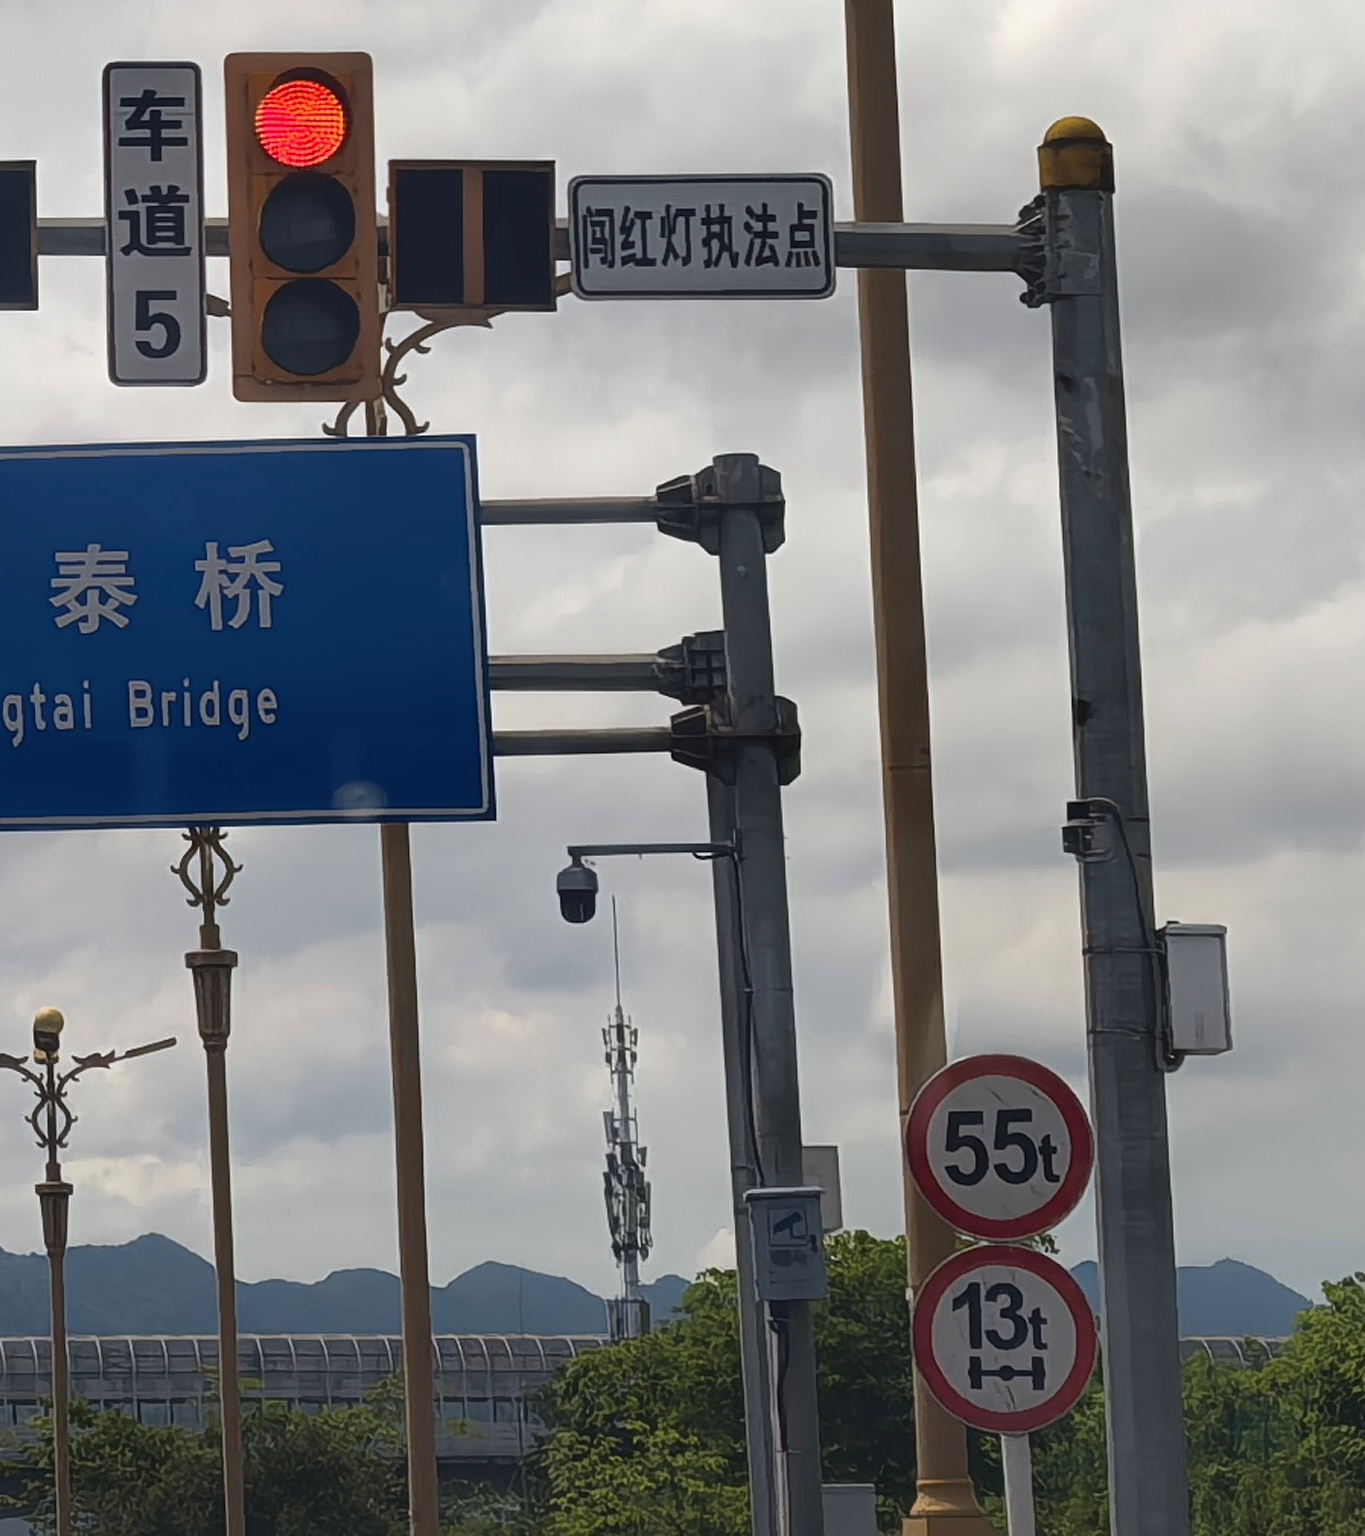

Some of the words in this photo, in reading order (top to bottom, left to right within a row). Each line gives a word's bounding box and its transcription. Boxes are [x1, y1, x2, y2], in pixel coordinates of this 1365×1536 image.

[582, 202, 821, 268] 闯红灯执法点
[127, 677, 279, 741] Bridge
[942, 1109, 1062, 1188] 55t
[951, 1281, 1049, 1352] 13t
